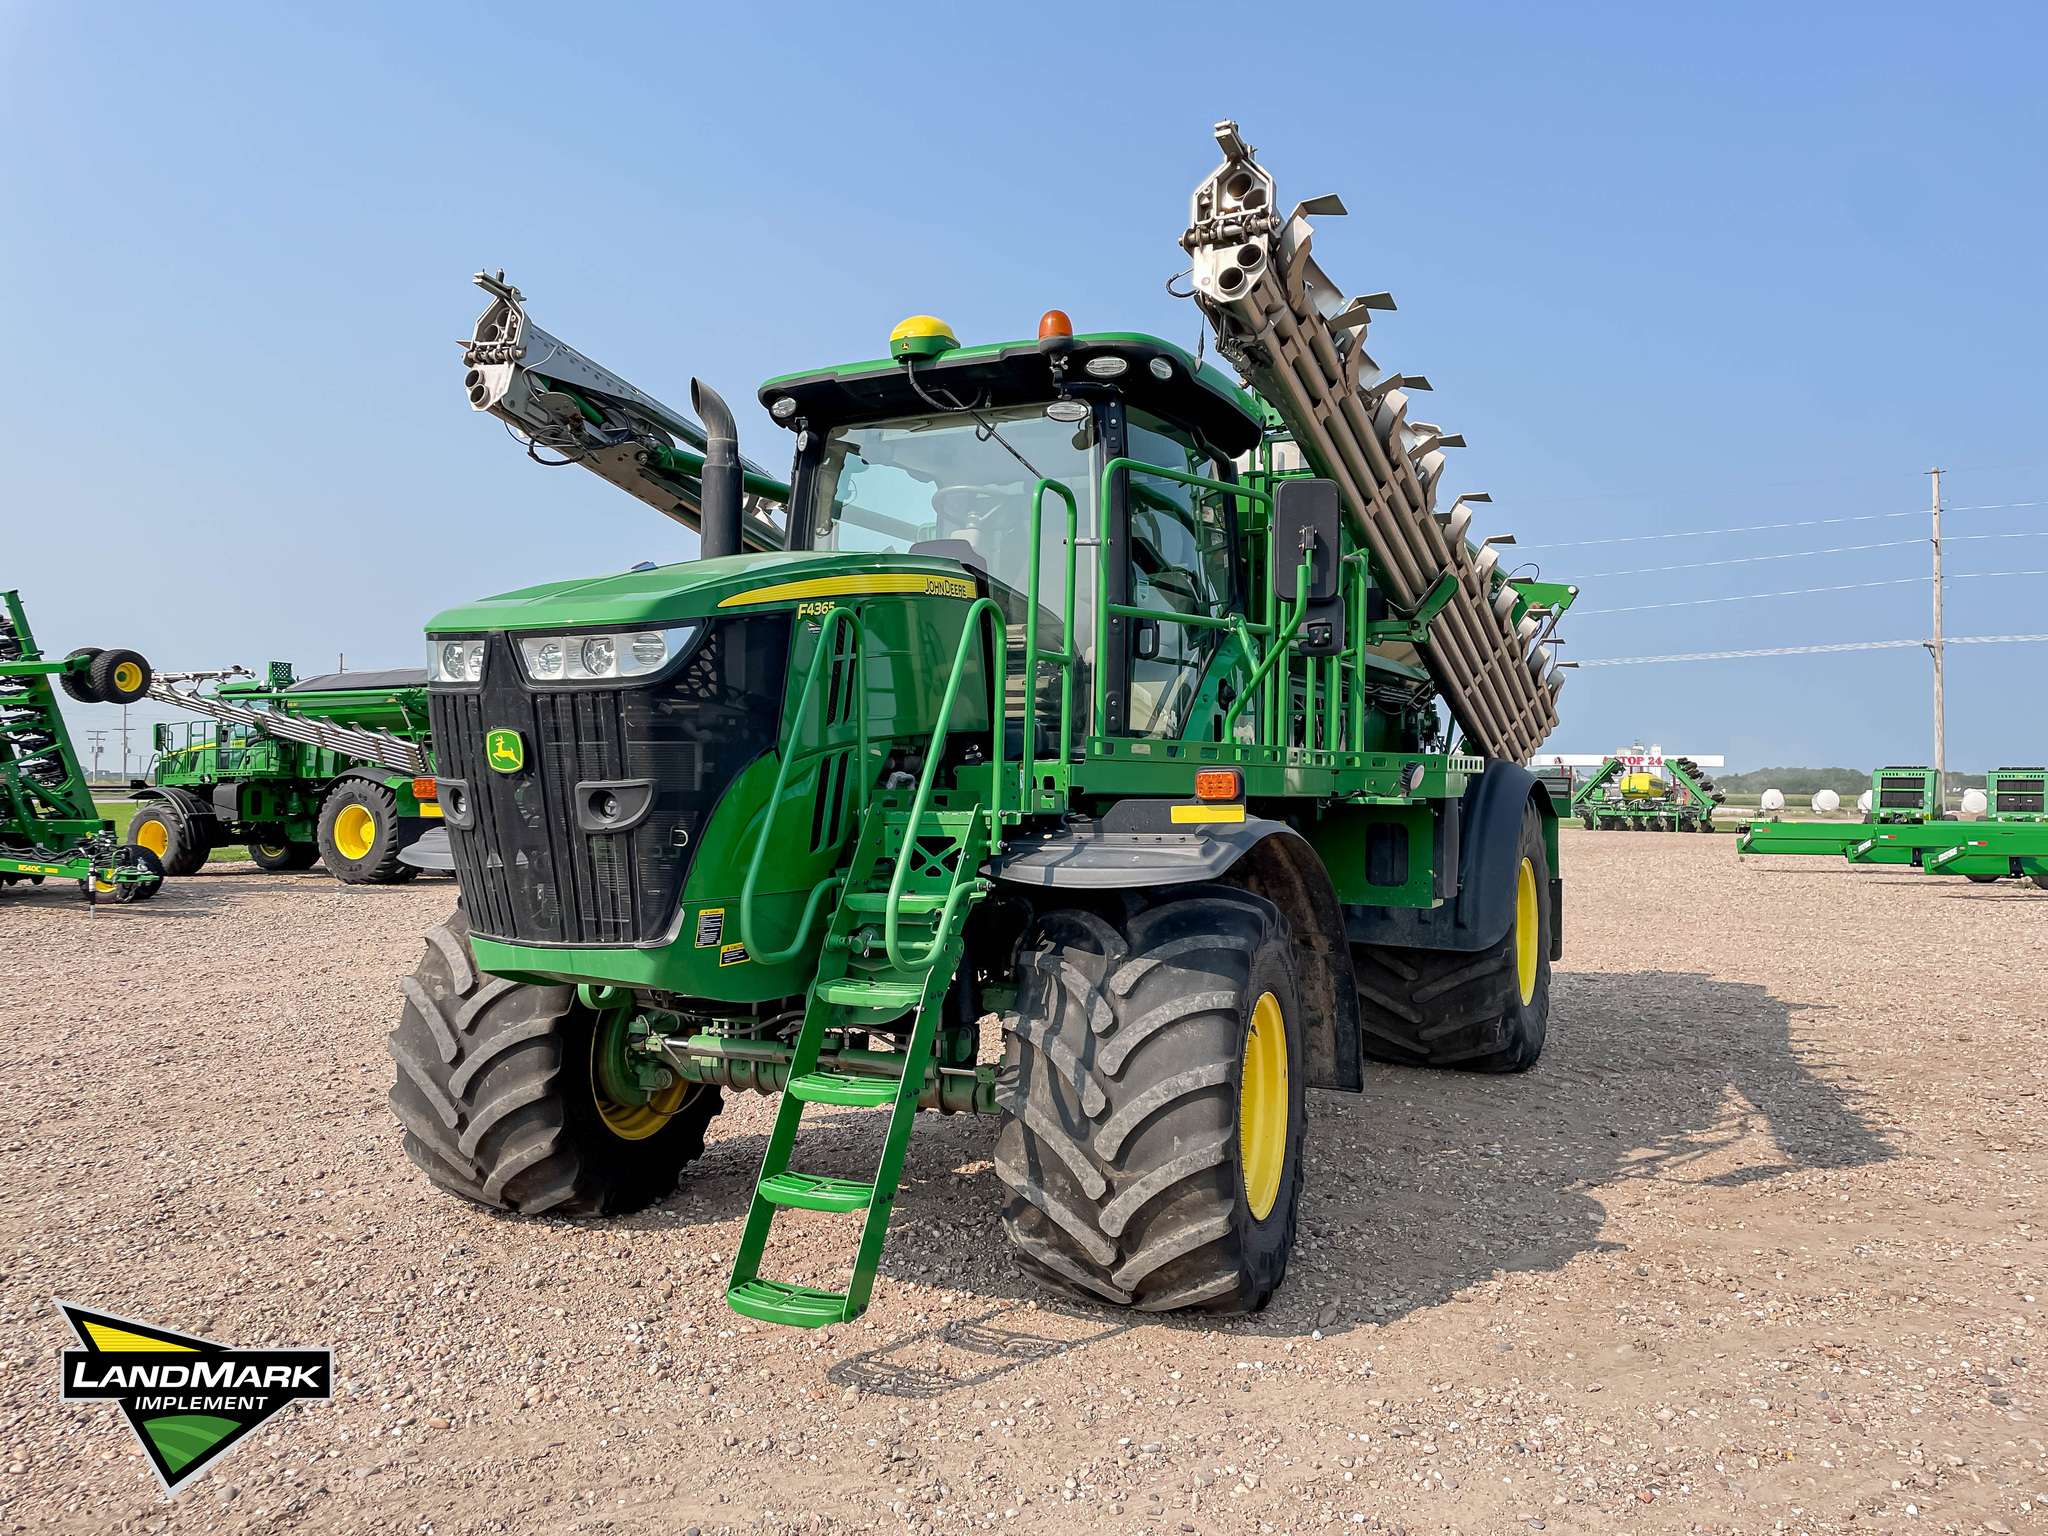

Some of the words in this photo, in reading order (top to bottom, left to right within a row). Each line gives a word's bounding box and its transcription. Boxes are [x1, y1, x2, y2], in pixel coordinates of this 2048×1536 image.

[797, 601, 836, 620] F4365
[1616, 756, 1645, 766] TOP
[1648, 756, 1663, 766] 24
